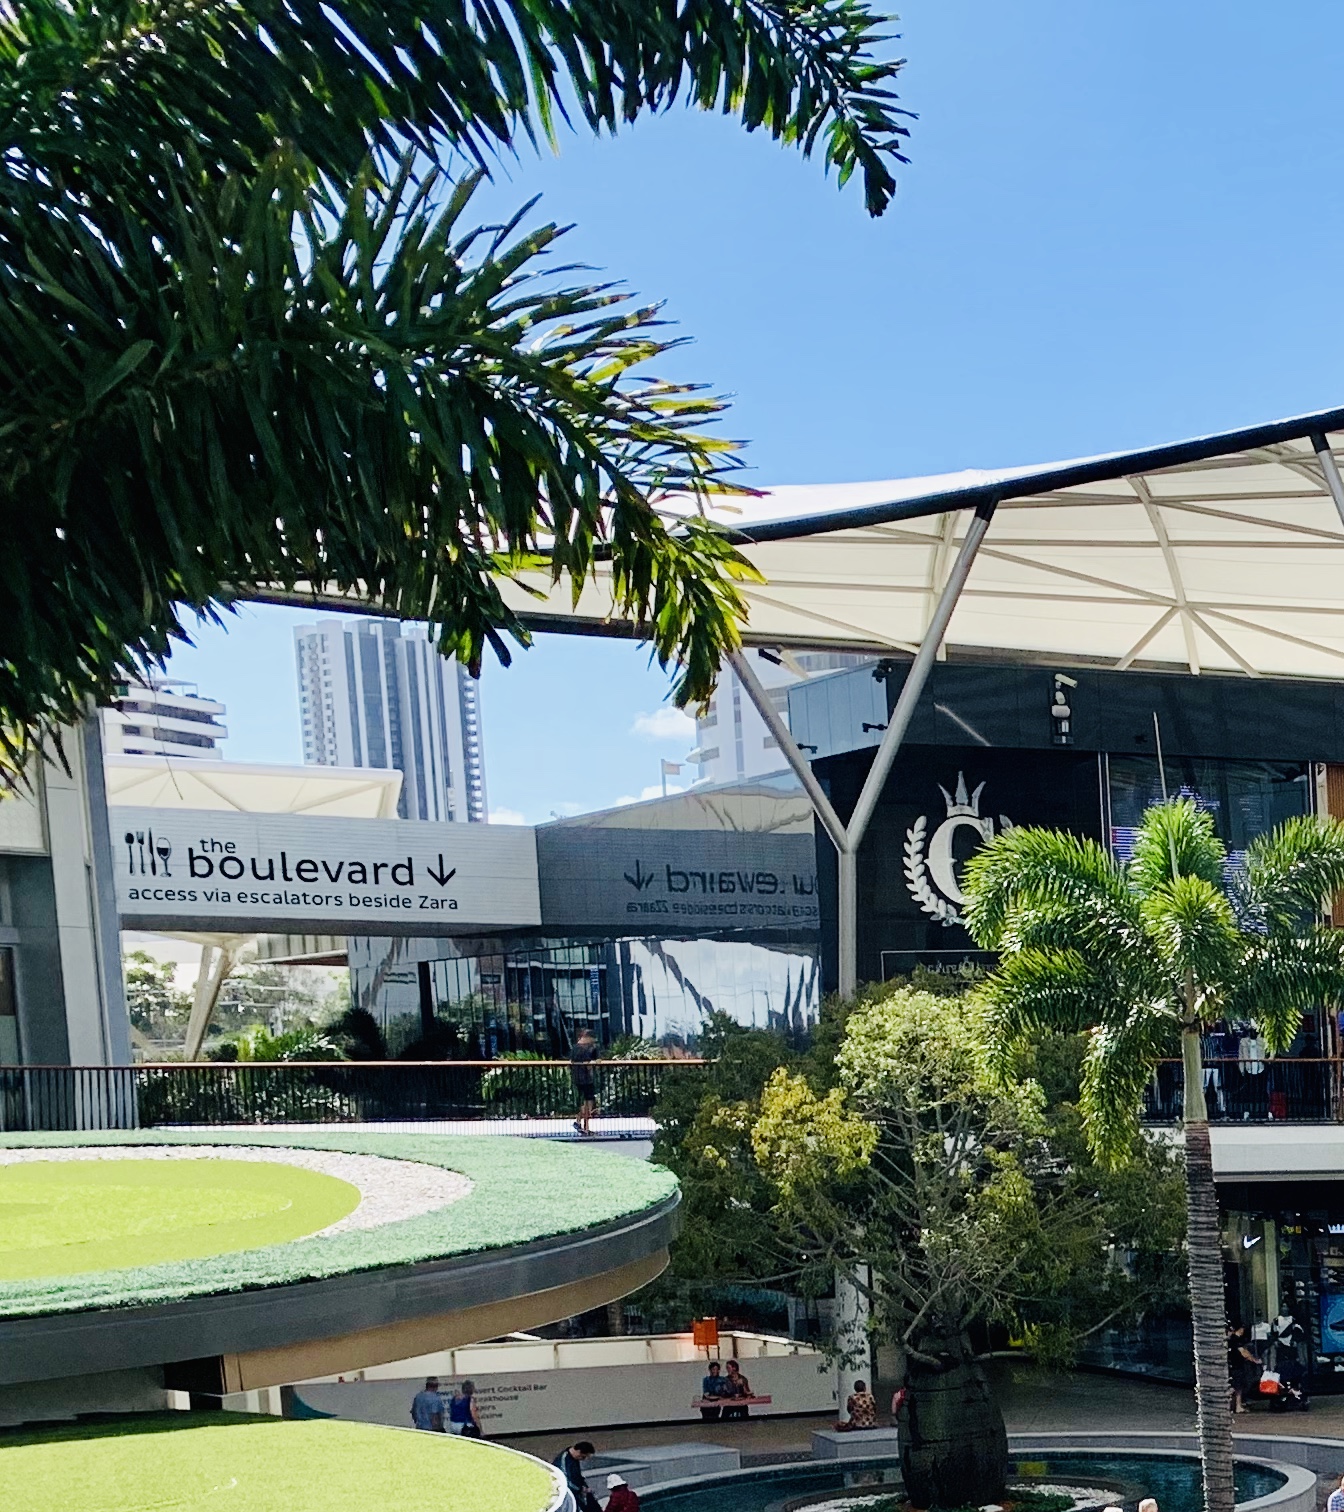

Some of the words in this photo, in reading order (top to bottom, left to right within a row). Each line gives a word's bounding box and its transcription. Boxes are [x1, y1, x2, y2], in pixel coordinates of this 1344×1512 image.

[200, 838, 236, 854] the
[188, 847, 415, 886] boulevard
[128, 887, 197, 902] access
[203, 888, 231, 903] via
[237, 888, 343, 907] escalators
[350, 892, 412, 910] beside
[418, 895, 458, 911] Zara
[497, 1385, 532, 1393] Cocktail
[533, 1383, 548, 1391] Bar
